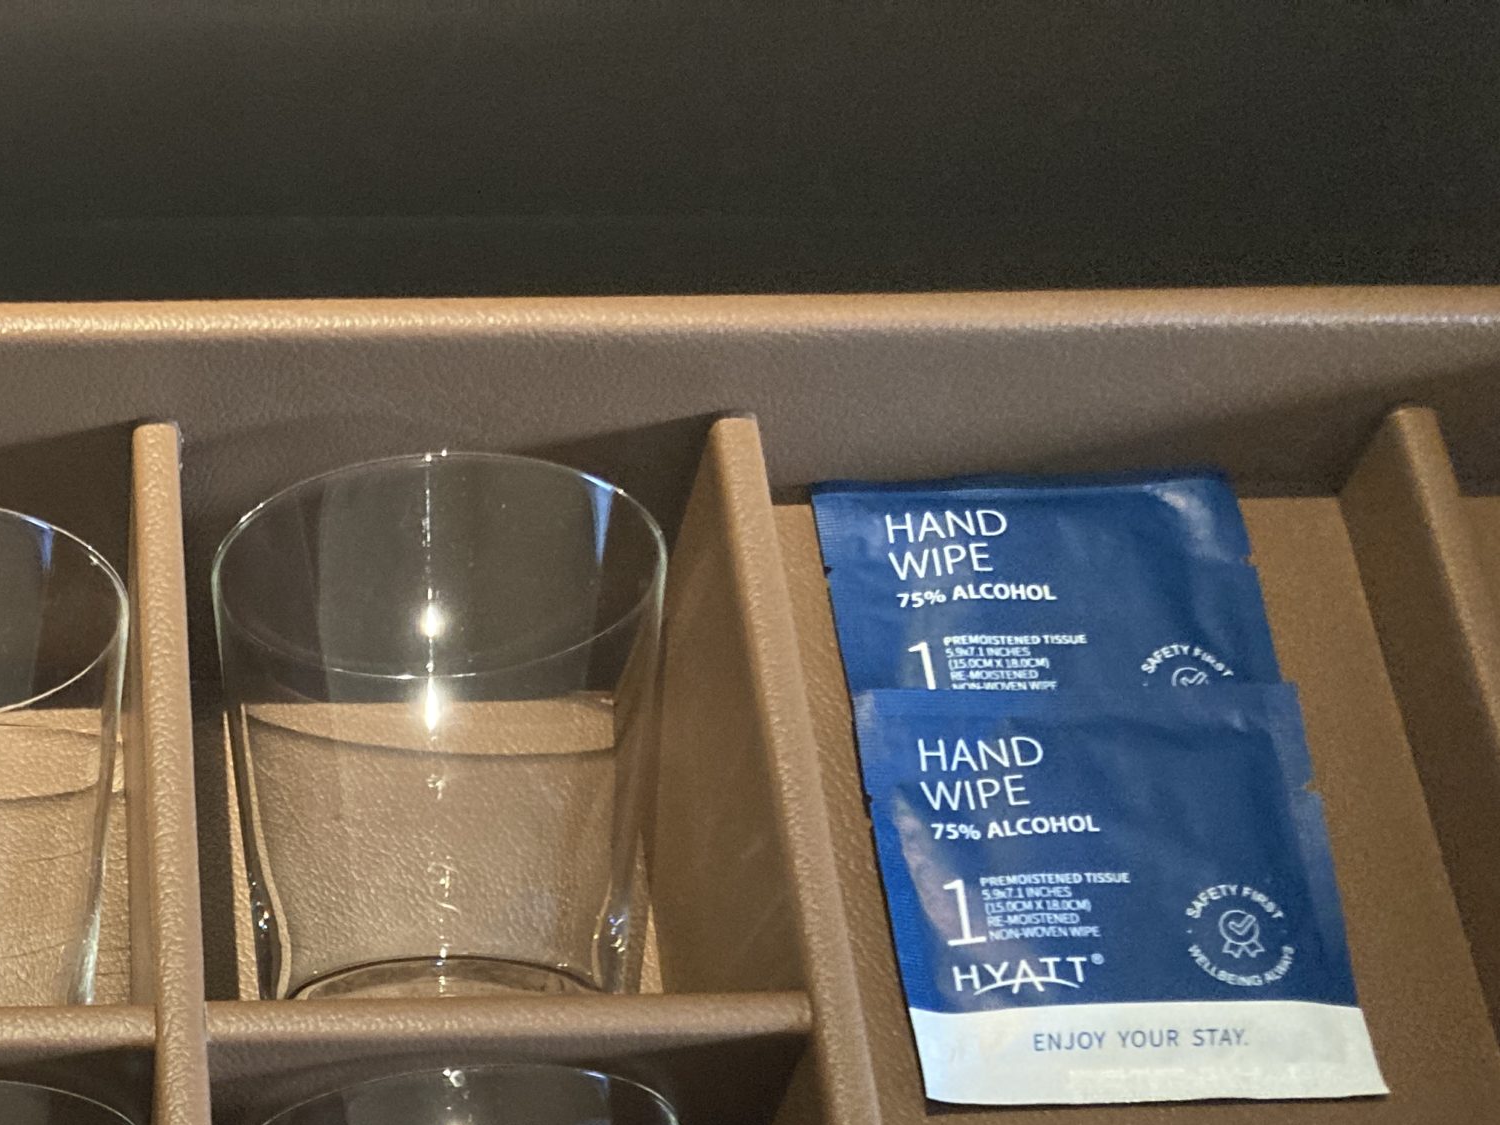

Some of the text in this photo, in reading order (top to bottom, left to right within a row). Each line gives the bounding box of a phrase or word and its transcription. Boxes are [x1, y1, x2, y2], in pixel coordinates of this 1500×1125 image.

[884, 509, 1008, 544] HAND
[887, 543, 995, 581] WIPE
[896, 583, 1058, 608] 75% ALCOHOL
[943, 634, 1088, 646] PREMOISTENED TISSUE
[986, 646, 1031, 657] INCHES
[907, 641, 937, 690] 1
[1141, 643, 1190, 674] SAFETY
[917, 736, 1044, 772] HAND
[919, 774, 1031, 811] WIPE
[930, 814, 1100, 840] 75% ALCOHOL
[979, 872, 1131, 887] PREMOISTENED TISSUE
[1025, 886, 1073, 898] INCHES
[943, 879, 987, 946] 1
[1185, 884, 1284, 919] SAFETY FIRST
[1070, 925, 1101, 938] WIPE
[1032, 1028, 1249, 1051] ENJOY YOUR STAY.
